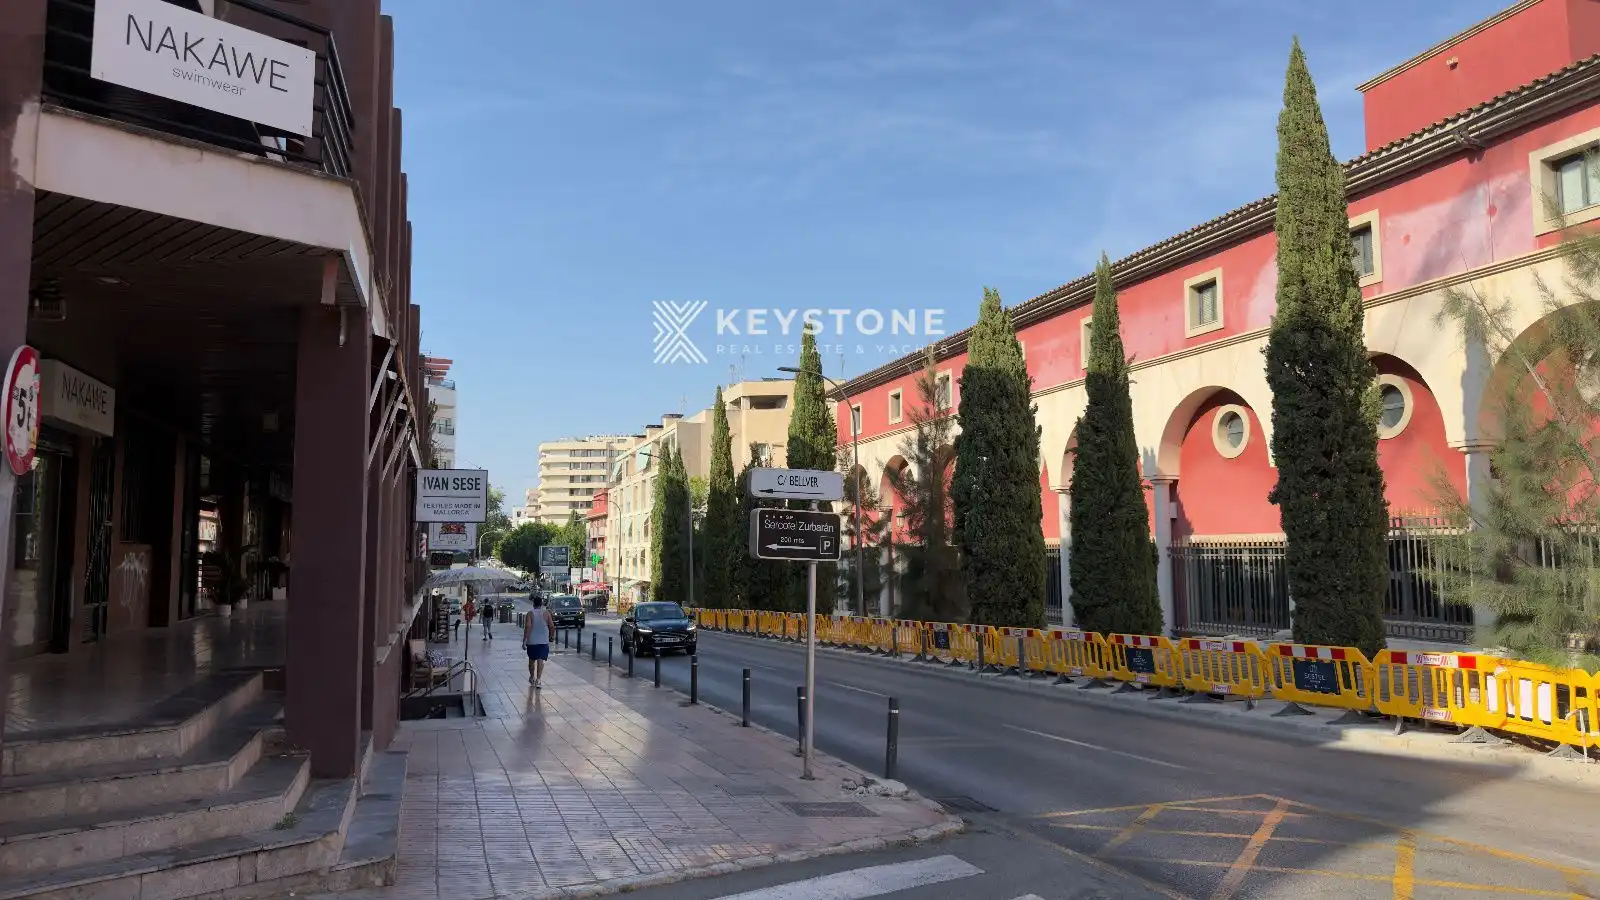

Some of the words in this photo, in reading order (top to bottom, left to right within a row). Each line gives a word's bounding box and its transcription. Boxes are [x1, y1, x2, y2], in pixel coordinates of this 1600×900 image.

[172, 66, 246, 95] swimwear
[423, 476, 449, 491] IVAN
[452, 477, 481, 491] SESE
[789, 475, 819, 488] BELLVER
[798, 521, 834, 533] Zurbarán
[823, 540, 831, 551] P
